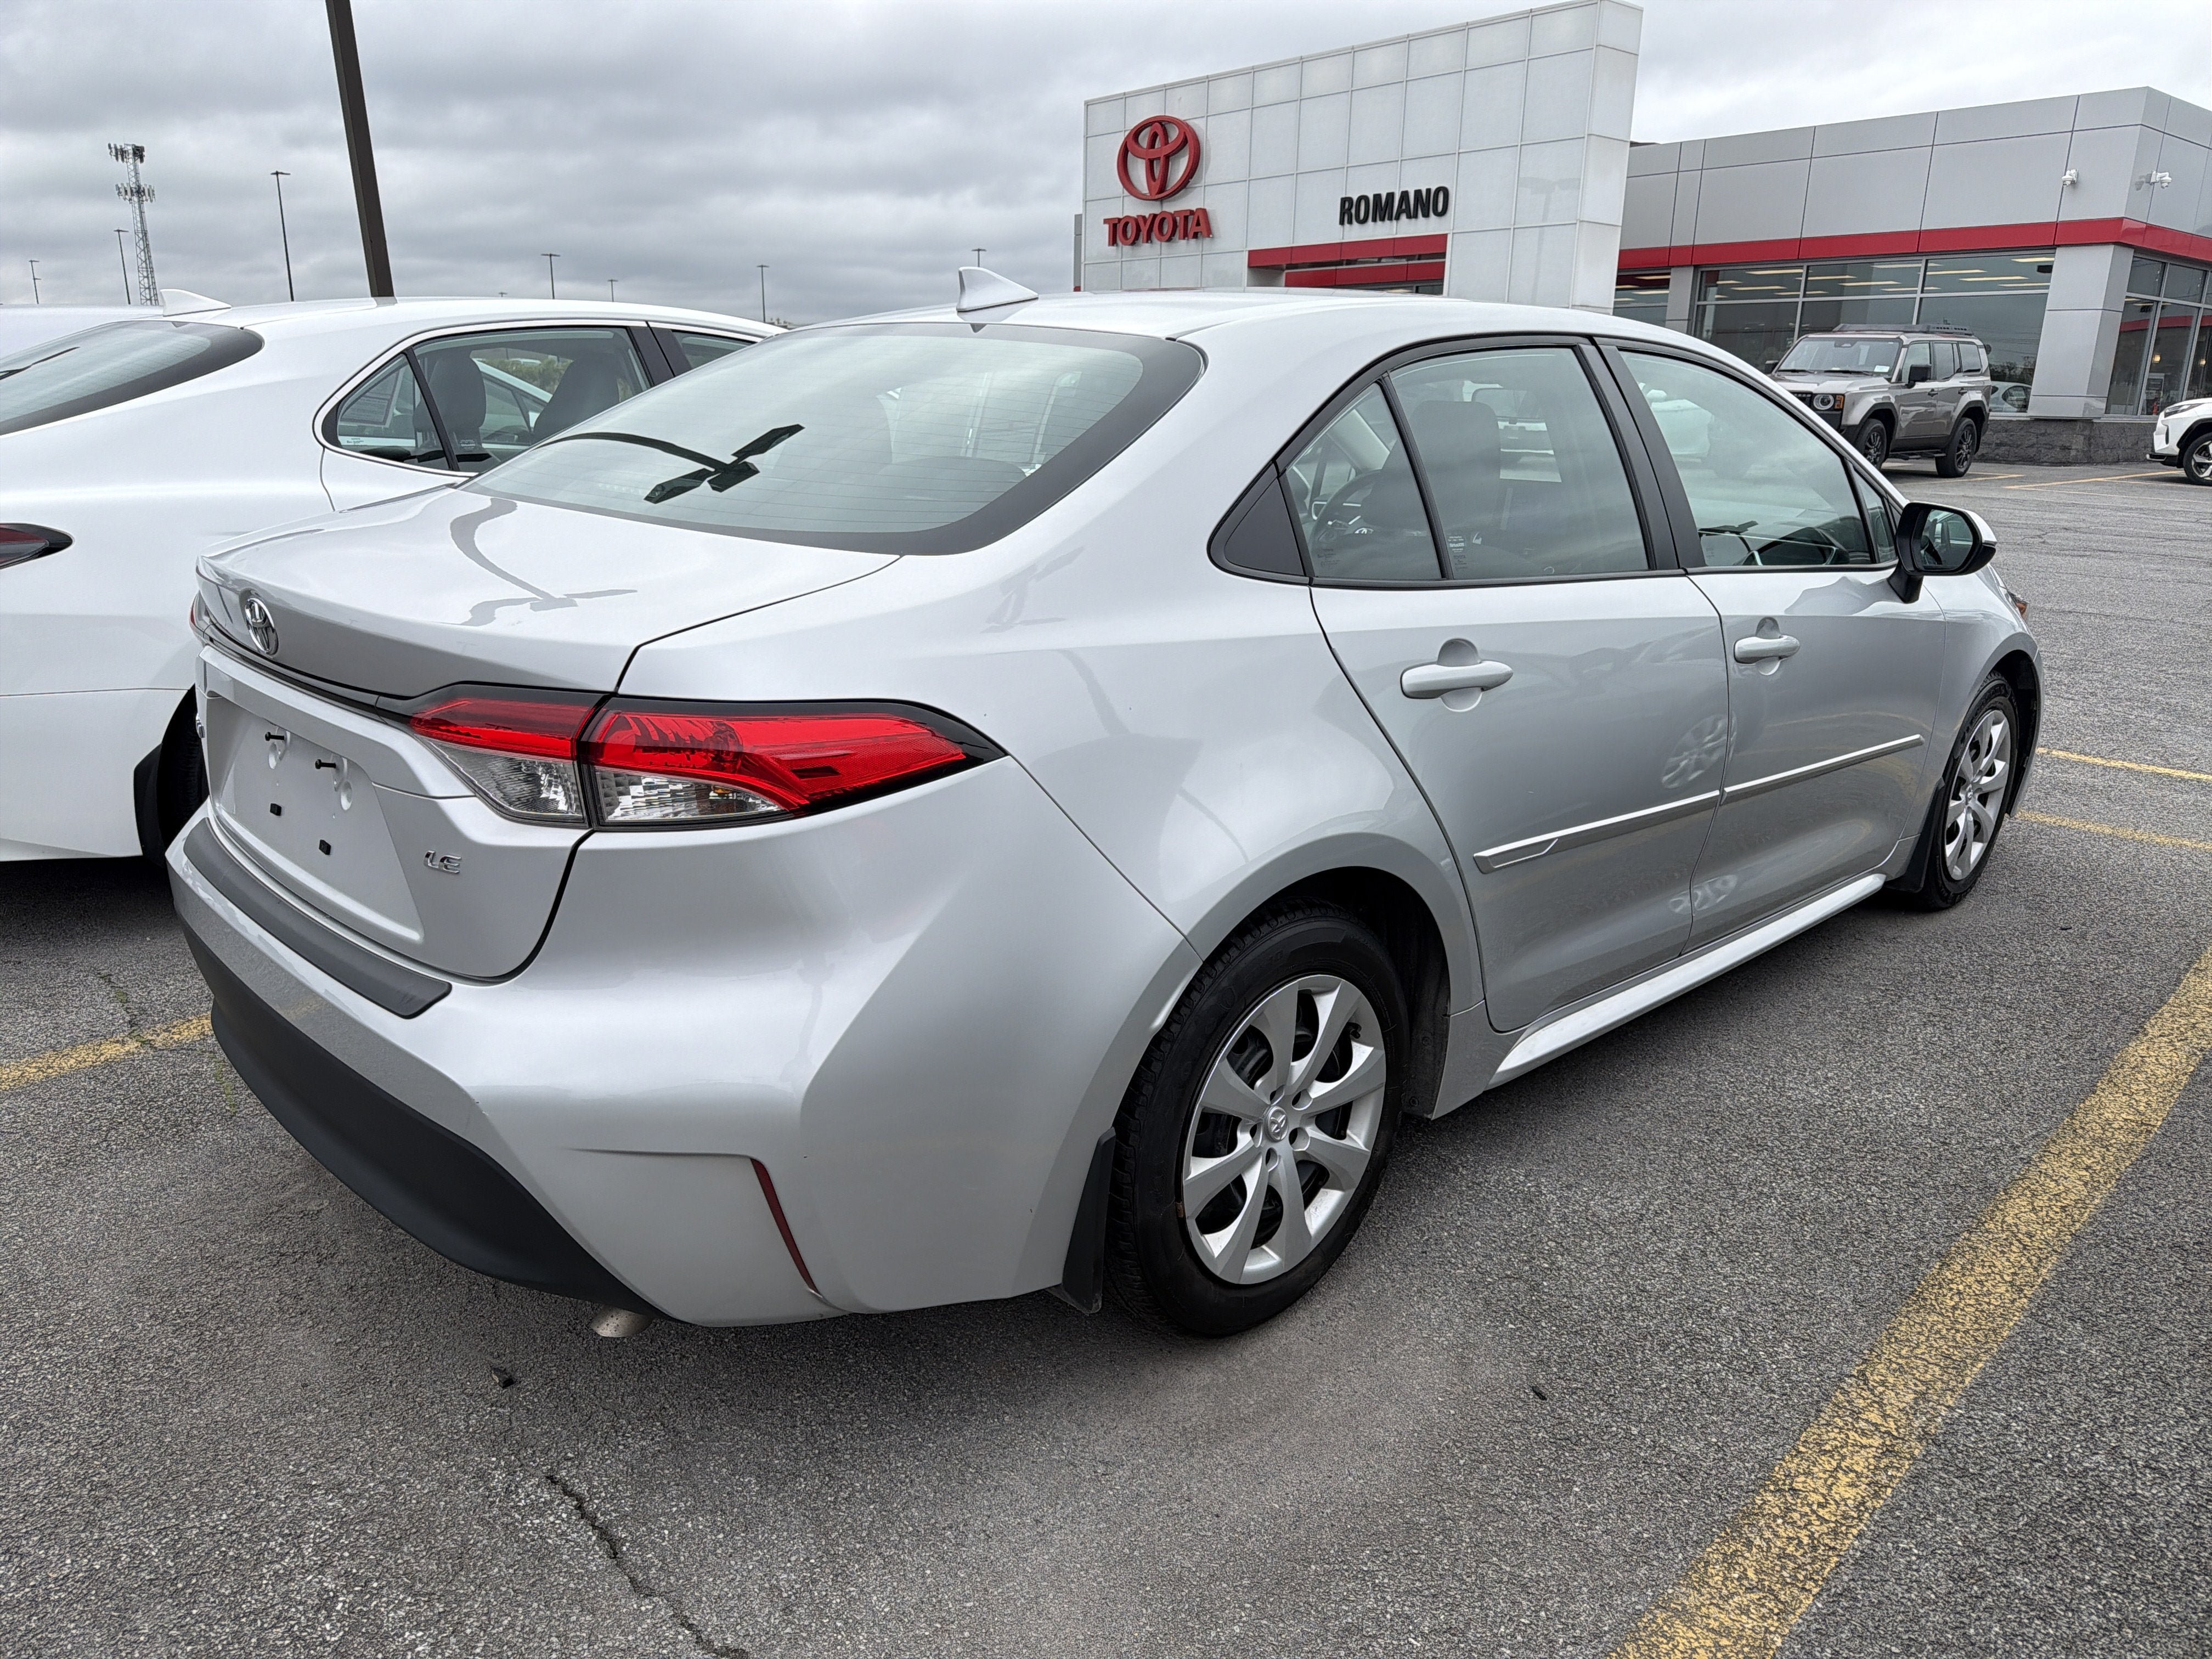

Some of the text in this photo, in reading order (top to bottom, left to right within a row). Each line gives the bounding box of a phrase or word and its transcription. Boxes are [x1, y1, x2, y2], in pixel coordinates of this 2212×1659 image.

[1339, 186, 1449, 225] ROMANO
[1103, 207, 1213, 246] TOYOTA
[423, 850, 461, 873] LE
